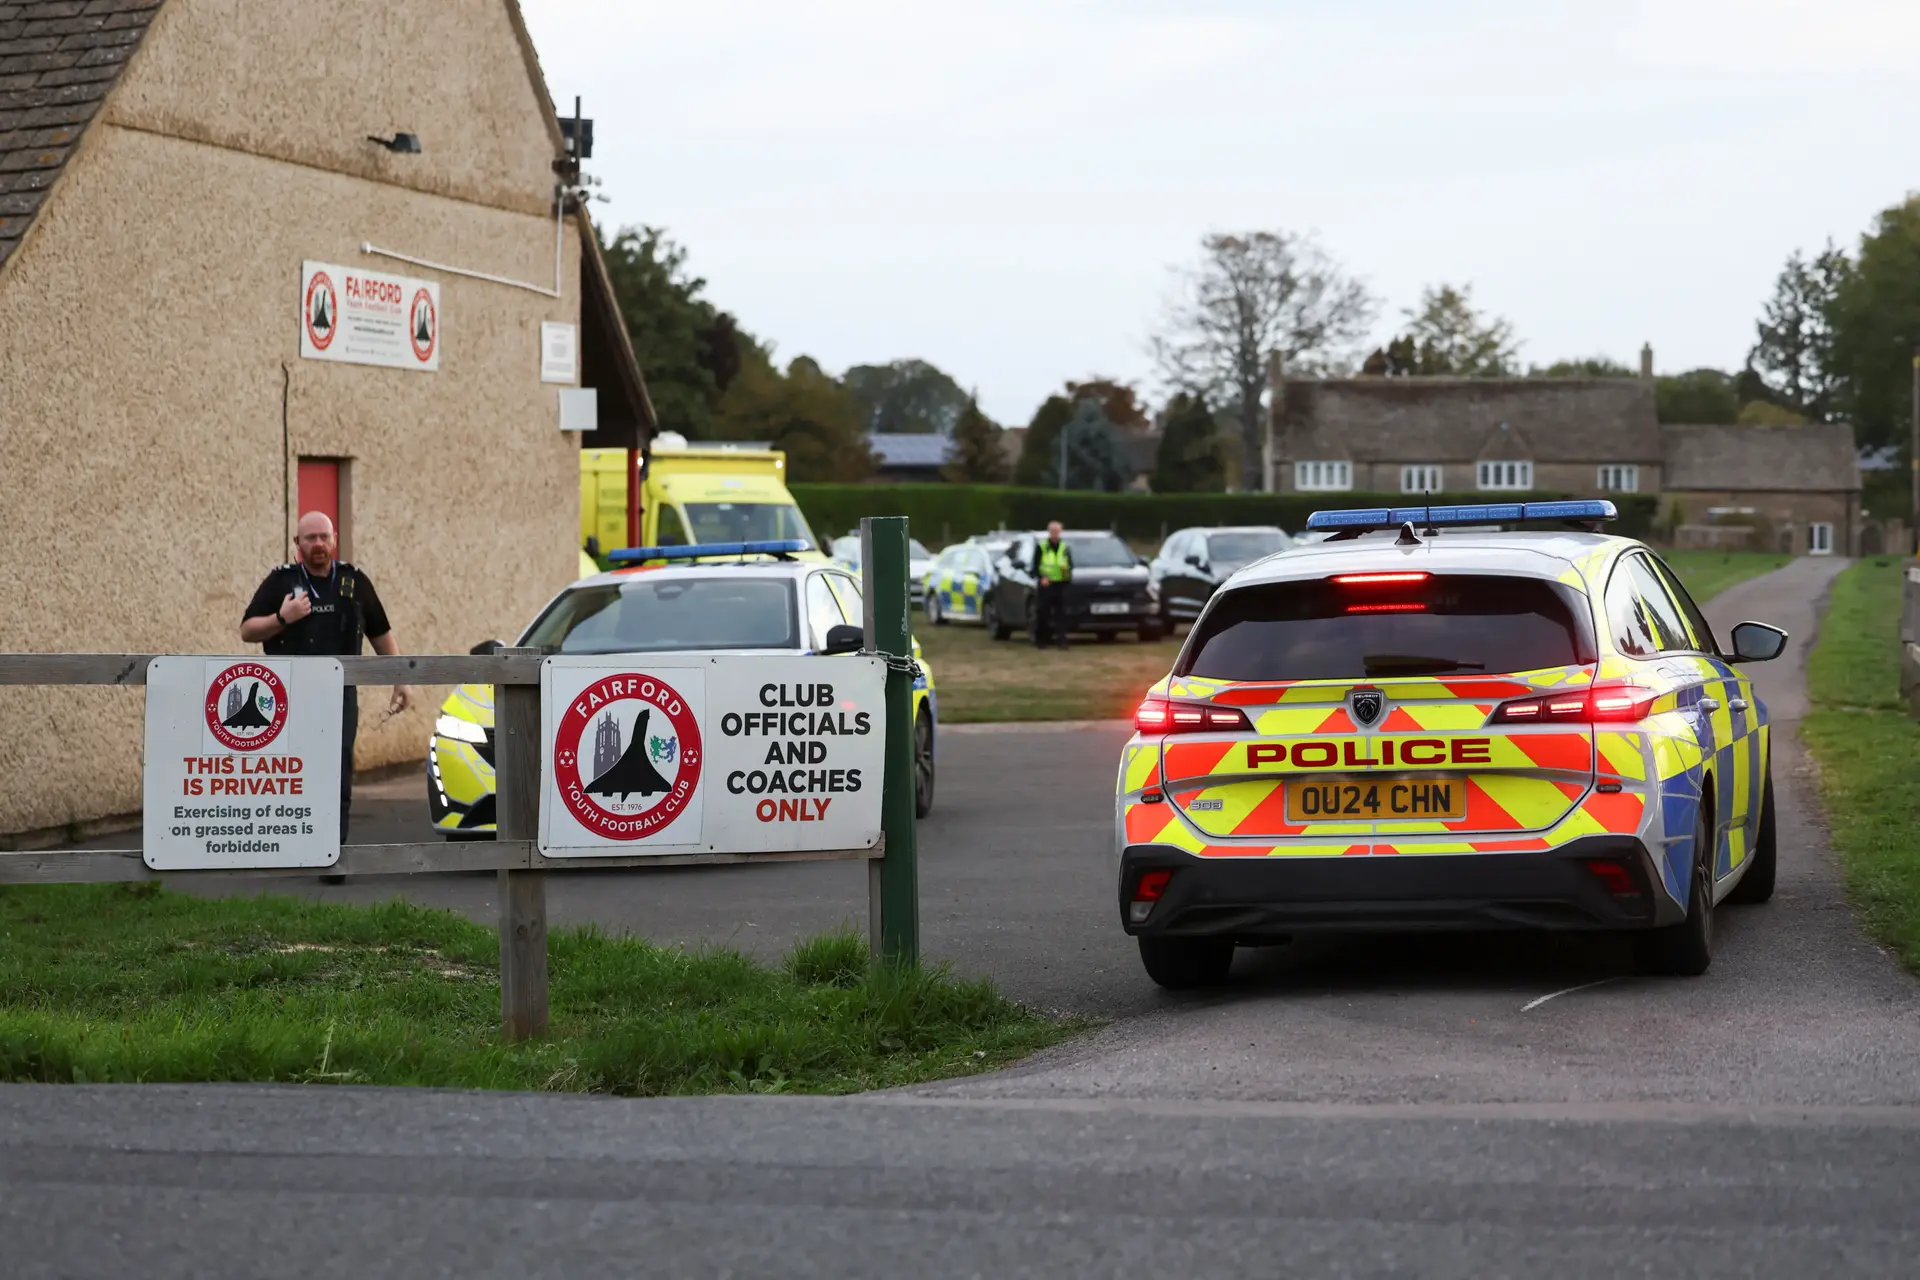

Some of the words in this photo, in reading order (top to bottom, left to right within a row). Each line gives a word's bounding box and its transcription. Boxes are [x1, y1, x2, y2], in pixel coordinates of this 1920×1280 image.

[346, 276, 402, 303] FAIRFORD
[312, 604, 335, 613] POLICE
[218, 666, 277, 687] FAIRFORD
[576, 679, 682, 718] FAIRFORD
[759, 683, 834, 707] CLUB
[212, 719, 230, 742] YOUTH
[231, 733, 268, 748] FOOTBALL
[267, 719, 281, 738] CLUB
[721, 712, 871, 736] OFFICIALS
[764, 741, 827, 765] AND
[1246, 738, 1492, 769] POLICE
[183, 757, 234, 774] THIS
[242, 757, 303, 774] LAND
[183, 778, 203, 795] IS
[210, 778, 303, 795] PRIVATE
[726, 769, 862, 794] COACHES
[567, 781, 598, 822] YOUTH
[600, 813, 665, 832] FOOTBALL
[666, 780, 690, 812] CLUB
[756, 798, 832, 822] ONLY
[1302, 785, 1380, 815] OU24
[1391, 784, 1451, 813] CHN
[174, 806, 251, 820] Exercising
[255, 805, 271, 817] of
[275, 805, 312, 820] dogs
[171, 825, 191, 836] on
[195, 822, 253, 838] grassed
[258, 824, 297, 835] areas
[301, 822, 313, 834] is
[206, 841, 280, 853] forbidden
